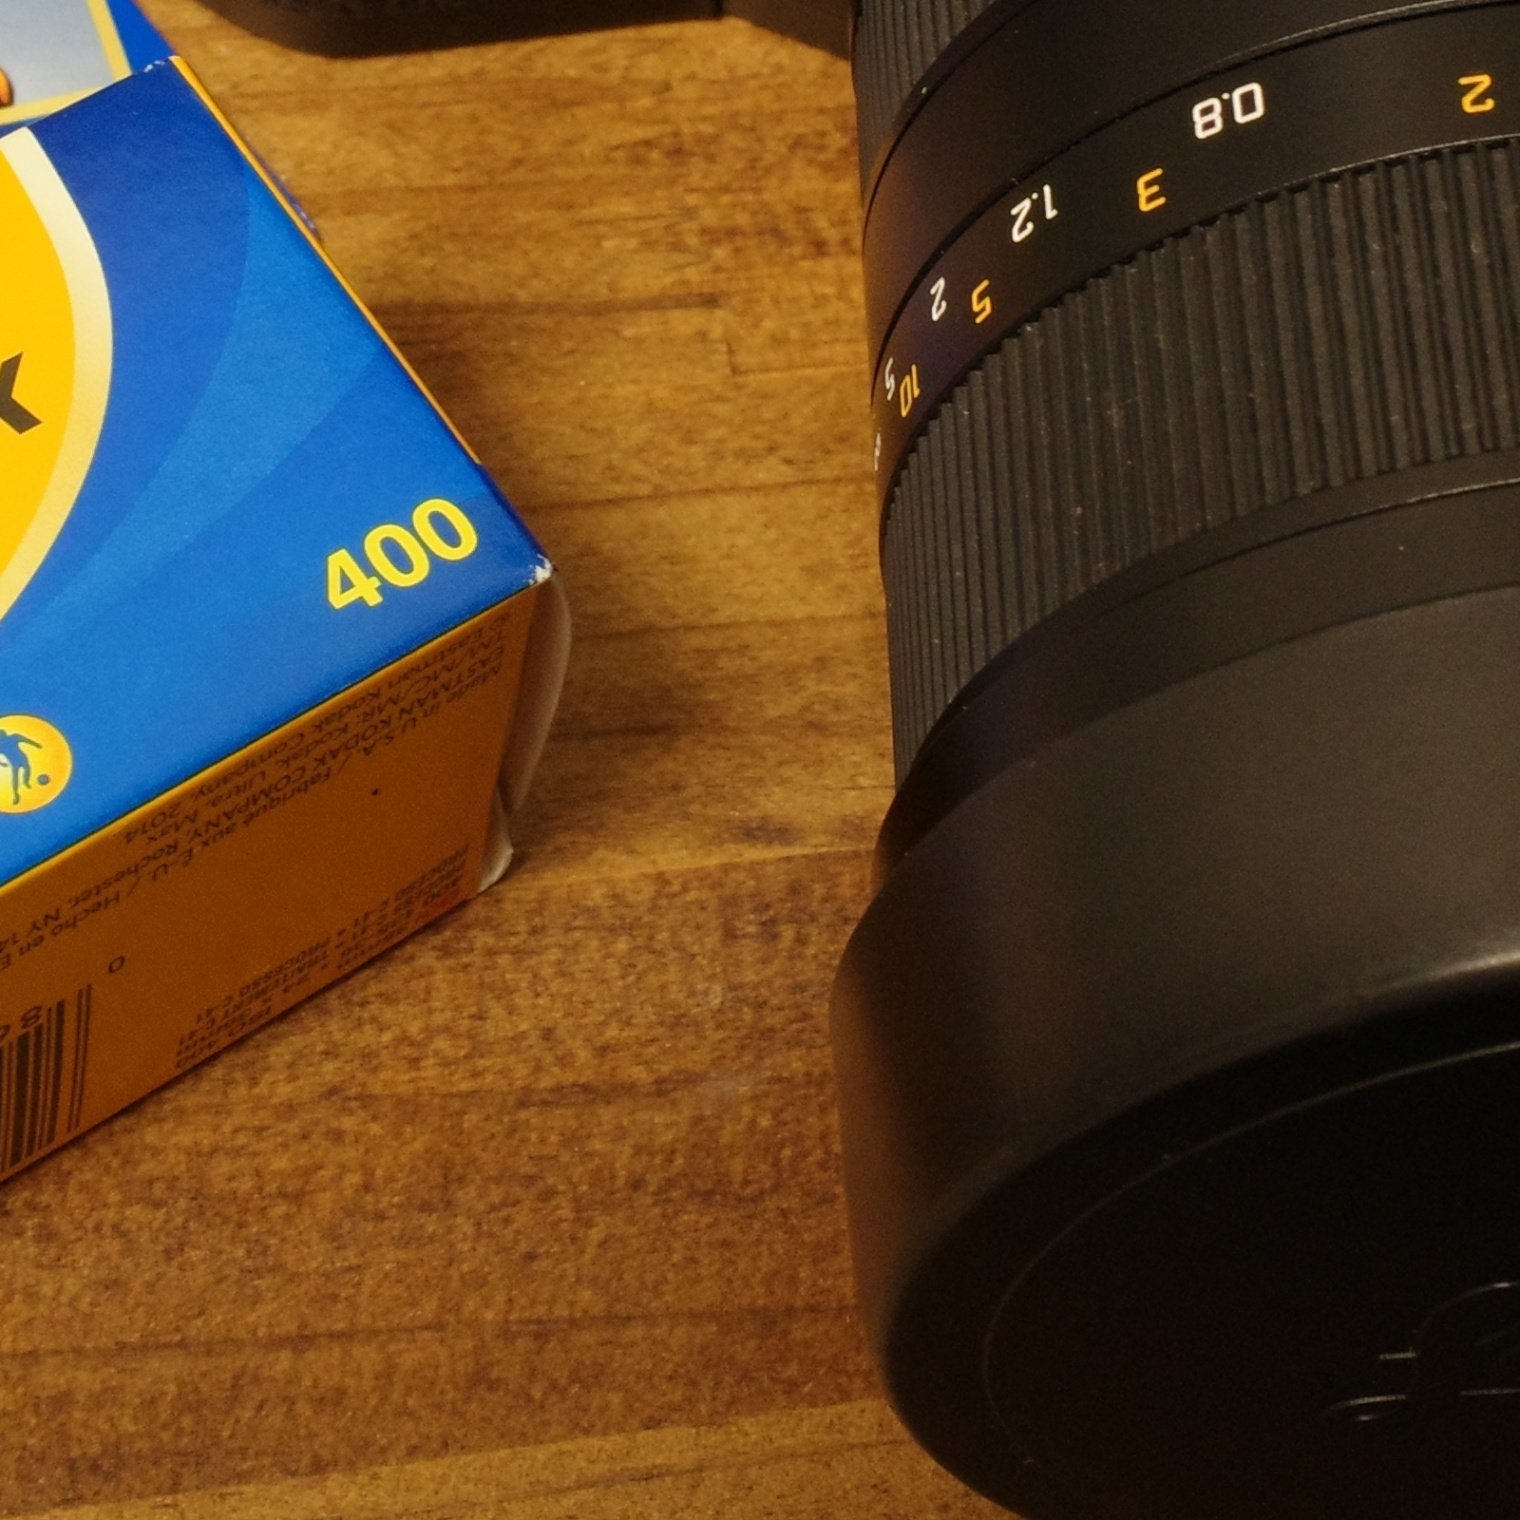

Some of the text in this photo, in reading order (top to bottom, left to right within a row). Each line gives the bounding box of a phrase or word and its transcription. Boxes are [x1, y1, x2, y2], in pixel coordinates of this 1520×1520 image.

[930, 276, 948, 322] 2
[1010, 183, 1059, 243] 1.2
[1191, 82, 1266, 140] 0.8
[899, 74, 1496, 418] 10 5 3 2
[327, 497, 479, 610] 400
[313, 713, 391, 770] KODAK
[123, 800, 180, 847] 2014
[26, 905, 60, 938] NY
[49, 887, 120, 942] Hecho
[18, 932, 44, 957] en
